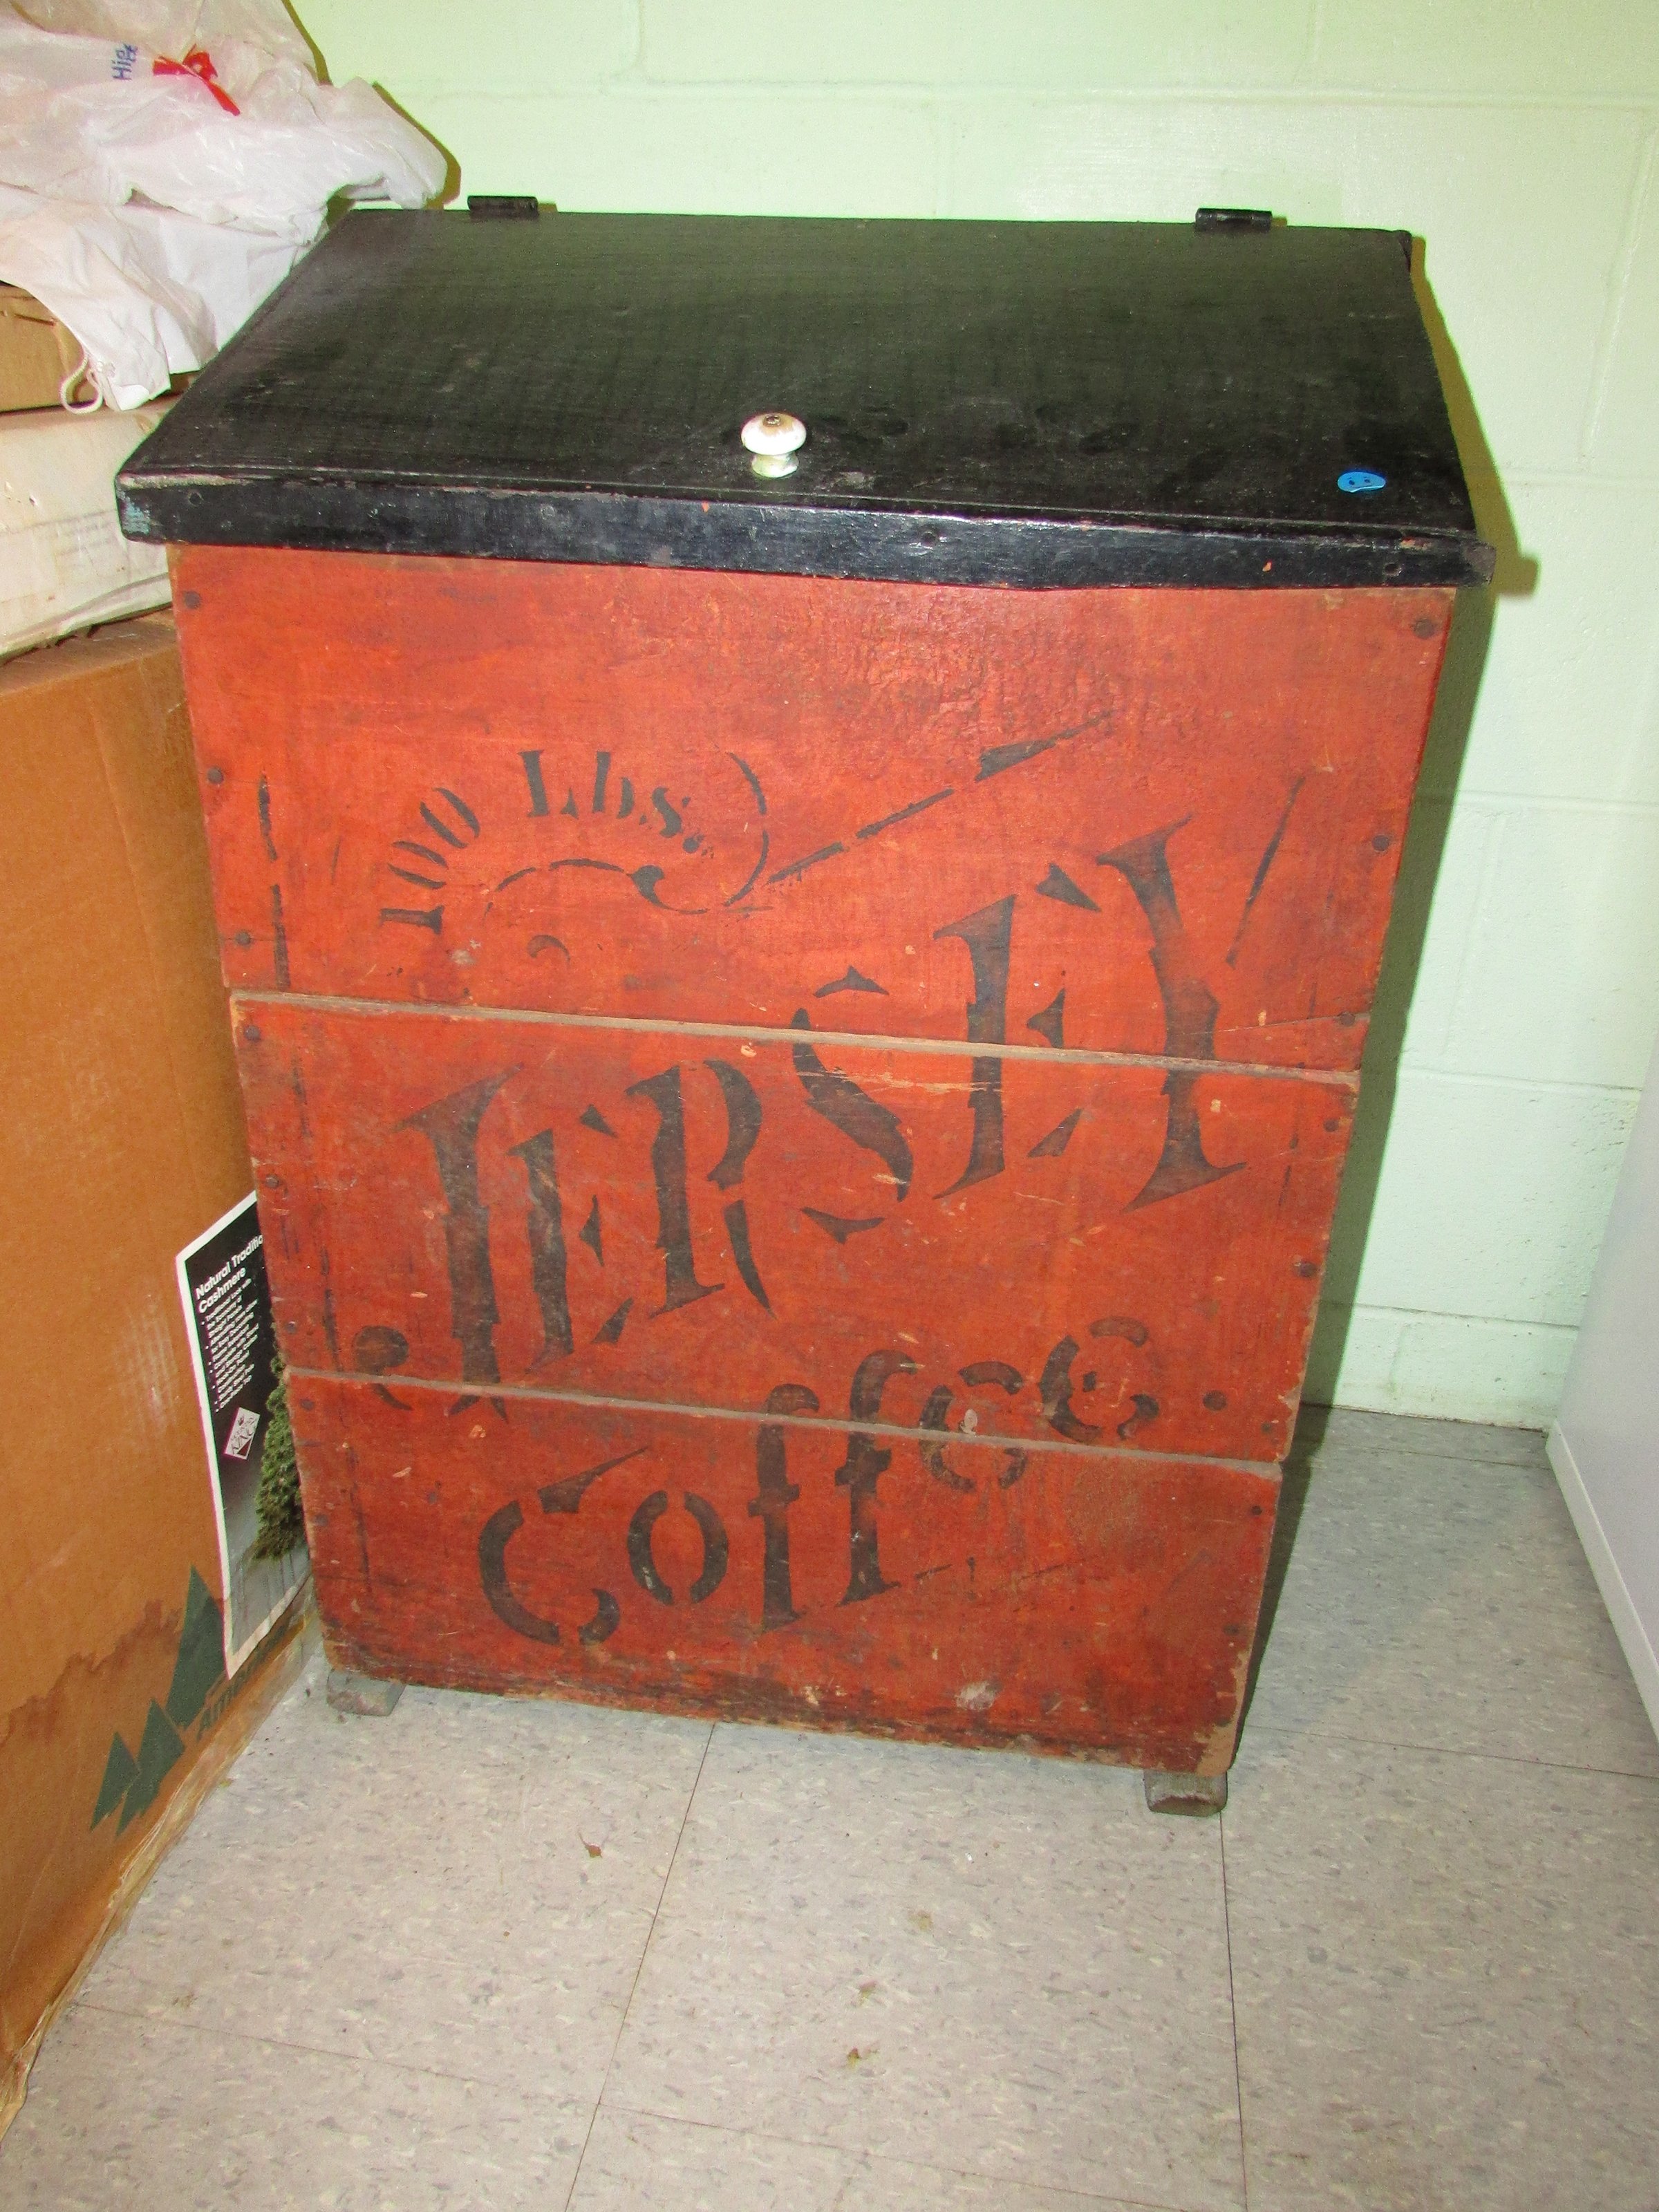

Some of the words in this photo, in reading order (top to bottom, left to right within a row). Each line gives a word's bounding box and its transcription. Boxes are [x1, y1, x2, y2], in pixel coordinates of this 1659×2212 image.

[379, 787, 480, 935] 100
[351, 778, 1304, 1423] JERSEY
[196, 1262, 231, 1300] Natural
[199, 1268, 245, 1313] Cashmere
[205, 1296, 231, 1322] Traditional
[216, 1301, 236, 1322] Economy
[229, 1312, 254, 1337] Decorating
[214, 1347, 236, 1369] Complete
[246, 1324, 259, 1338] Stand
[225, 1349, 243, 1368] Storage
